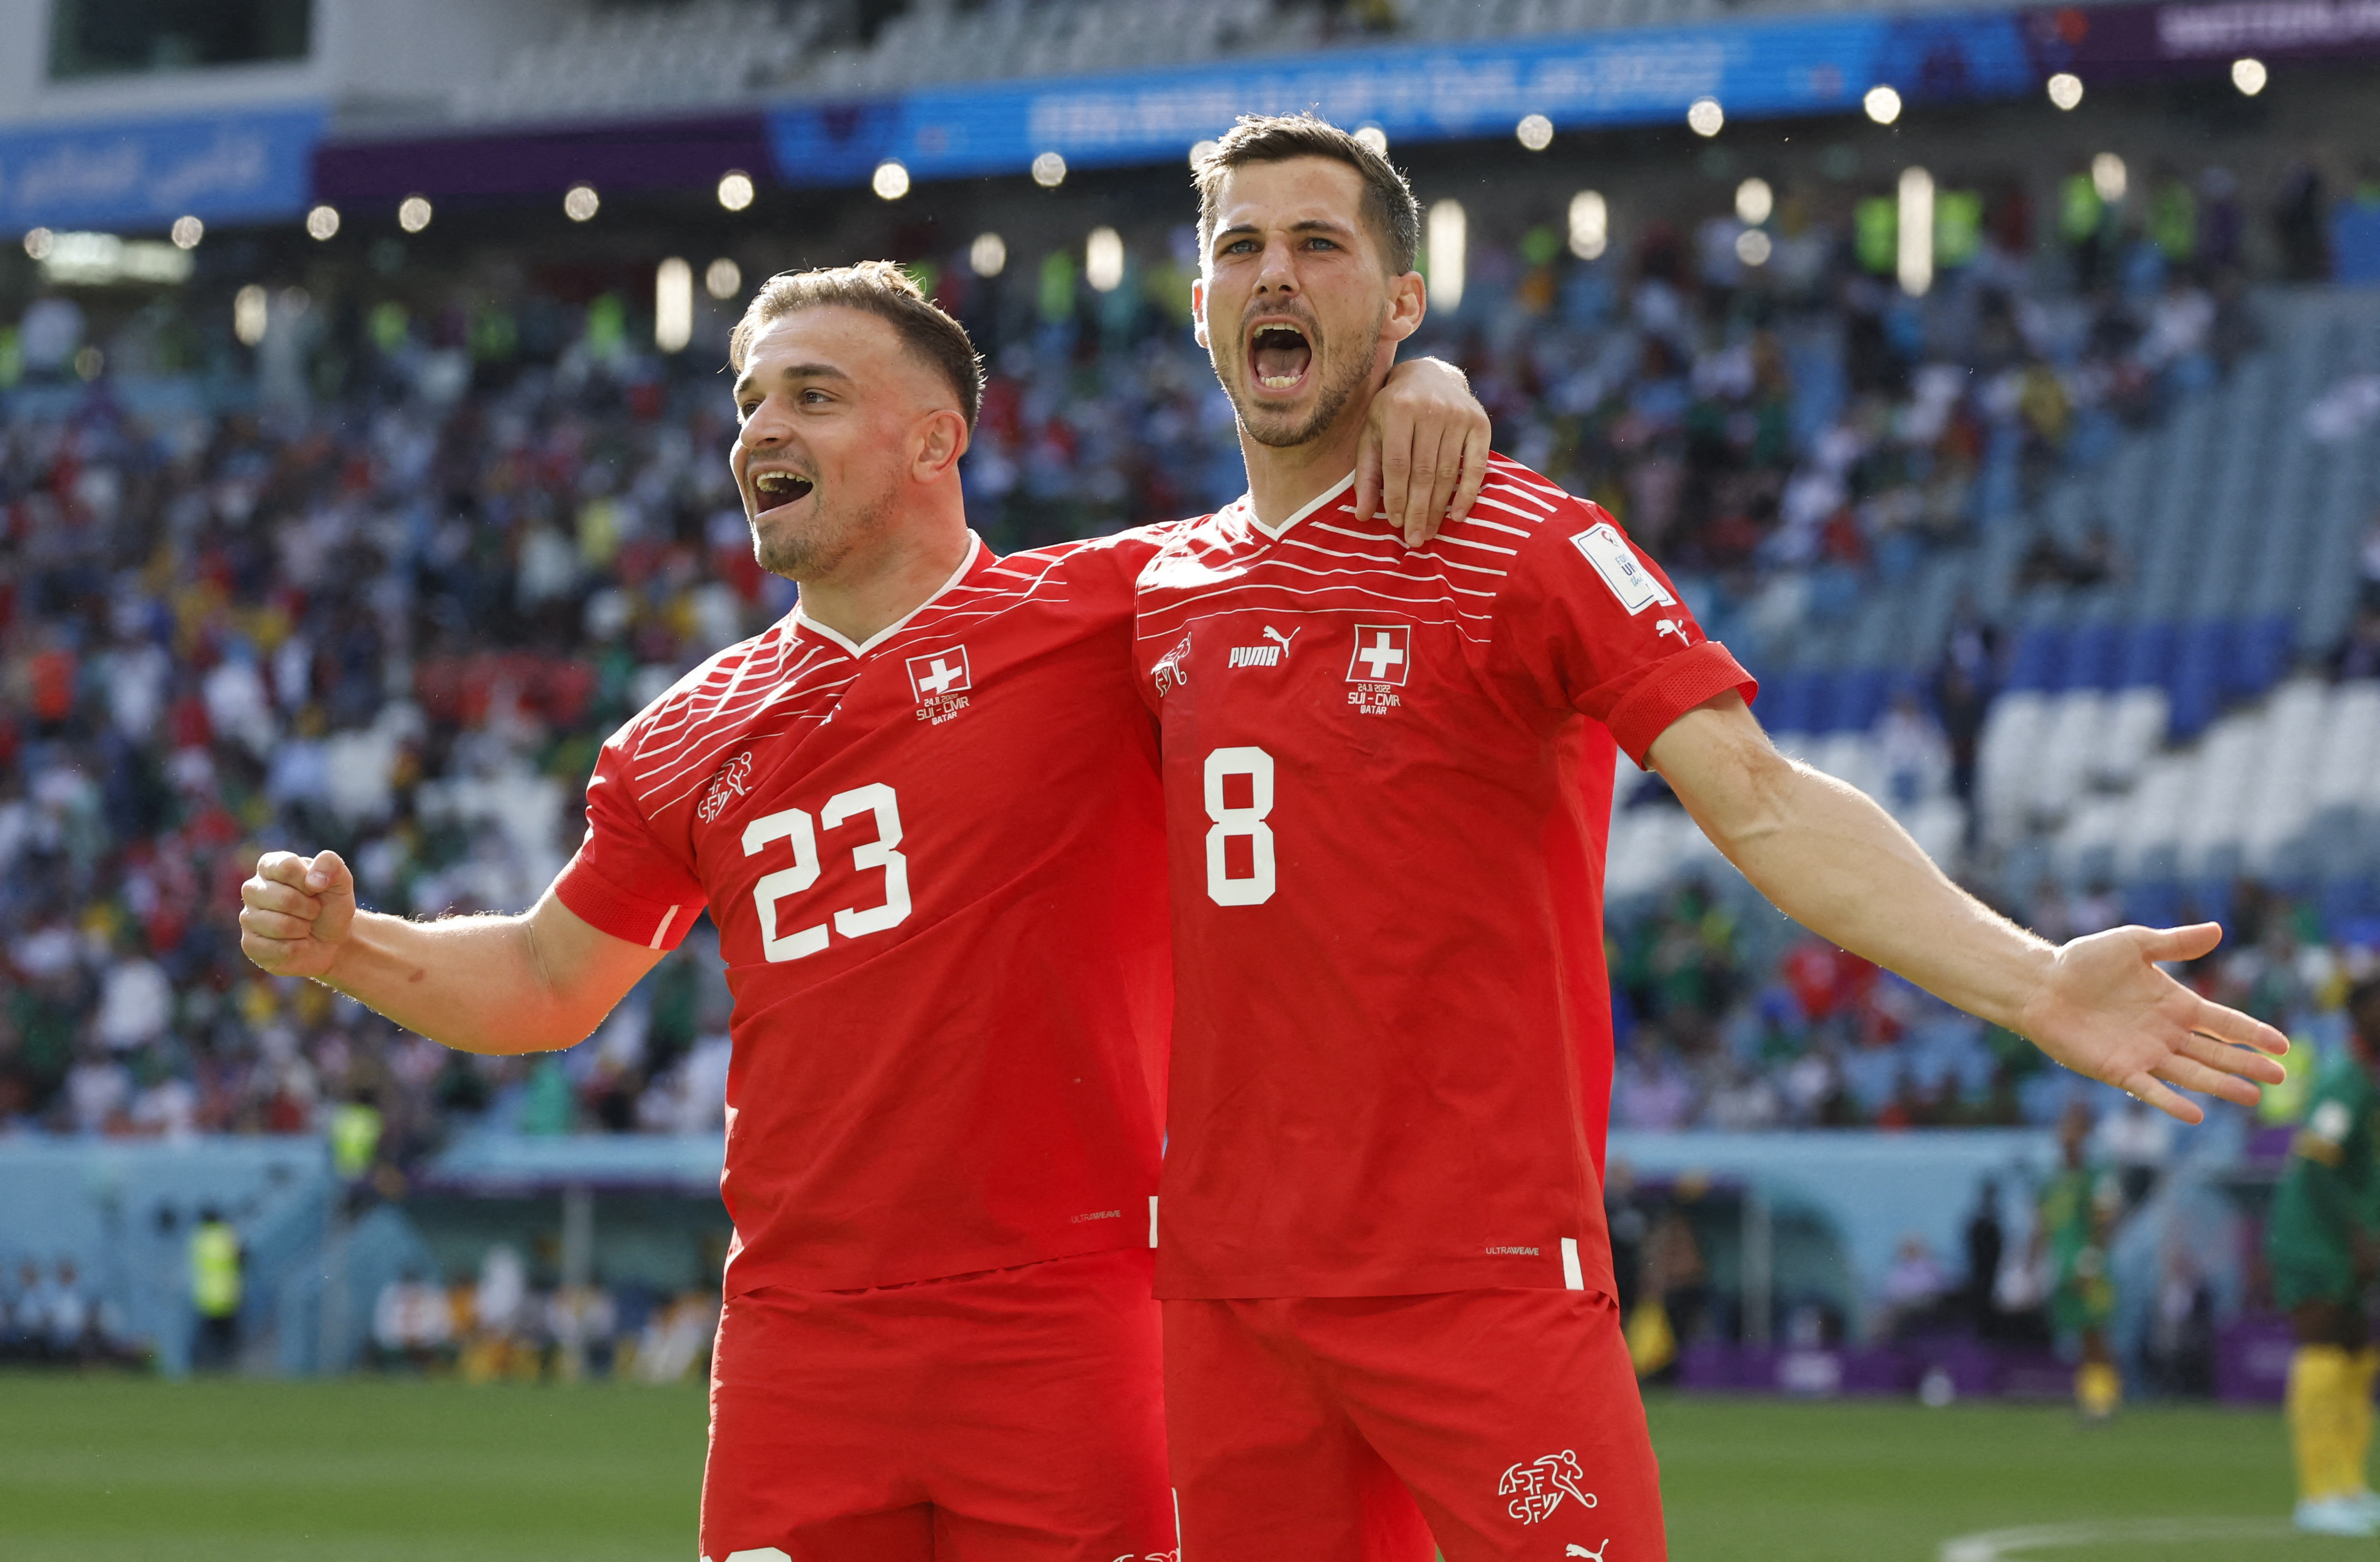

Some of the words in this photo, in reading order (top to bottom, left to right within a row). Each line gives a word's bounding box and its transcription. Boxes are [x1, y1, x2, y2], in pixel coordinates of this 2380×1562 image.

[1228, 646, 1280, 669] PUMA
[1347, 692, 1366, 704] SUI
[1375, 694, 1401, 707] CMR
[916, 707, 935, 721] SUI
[943, 696, 970, 713] CMR
[1360, 705, 1387, 715] QATAR
[931, 711, 958, 725] QATAR
[1204, 746, 1277, 907] 8
[741, 782, 913, 963] 23
[1071, 1210, 1122, 1223] ULTRAWEAVE
[1485, 1246, 1539, 1256] ULTRAWEAVE
